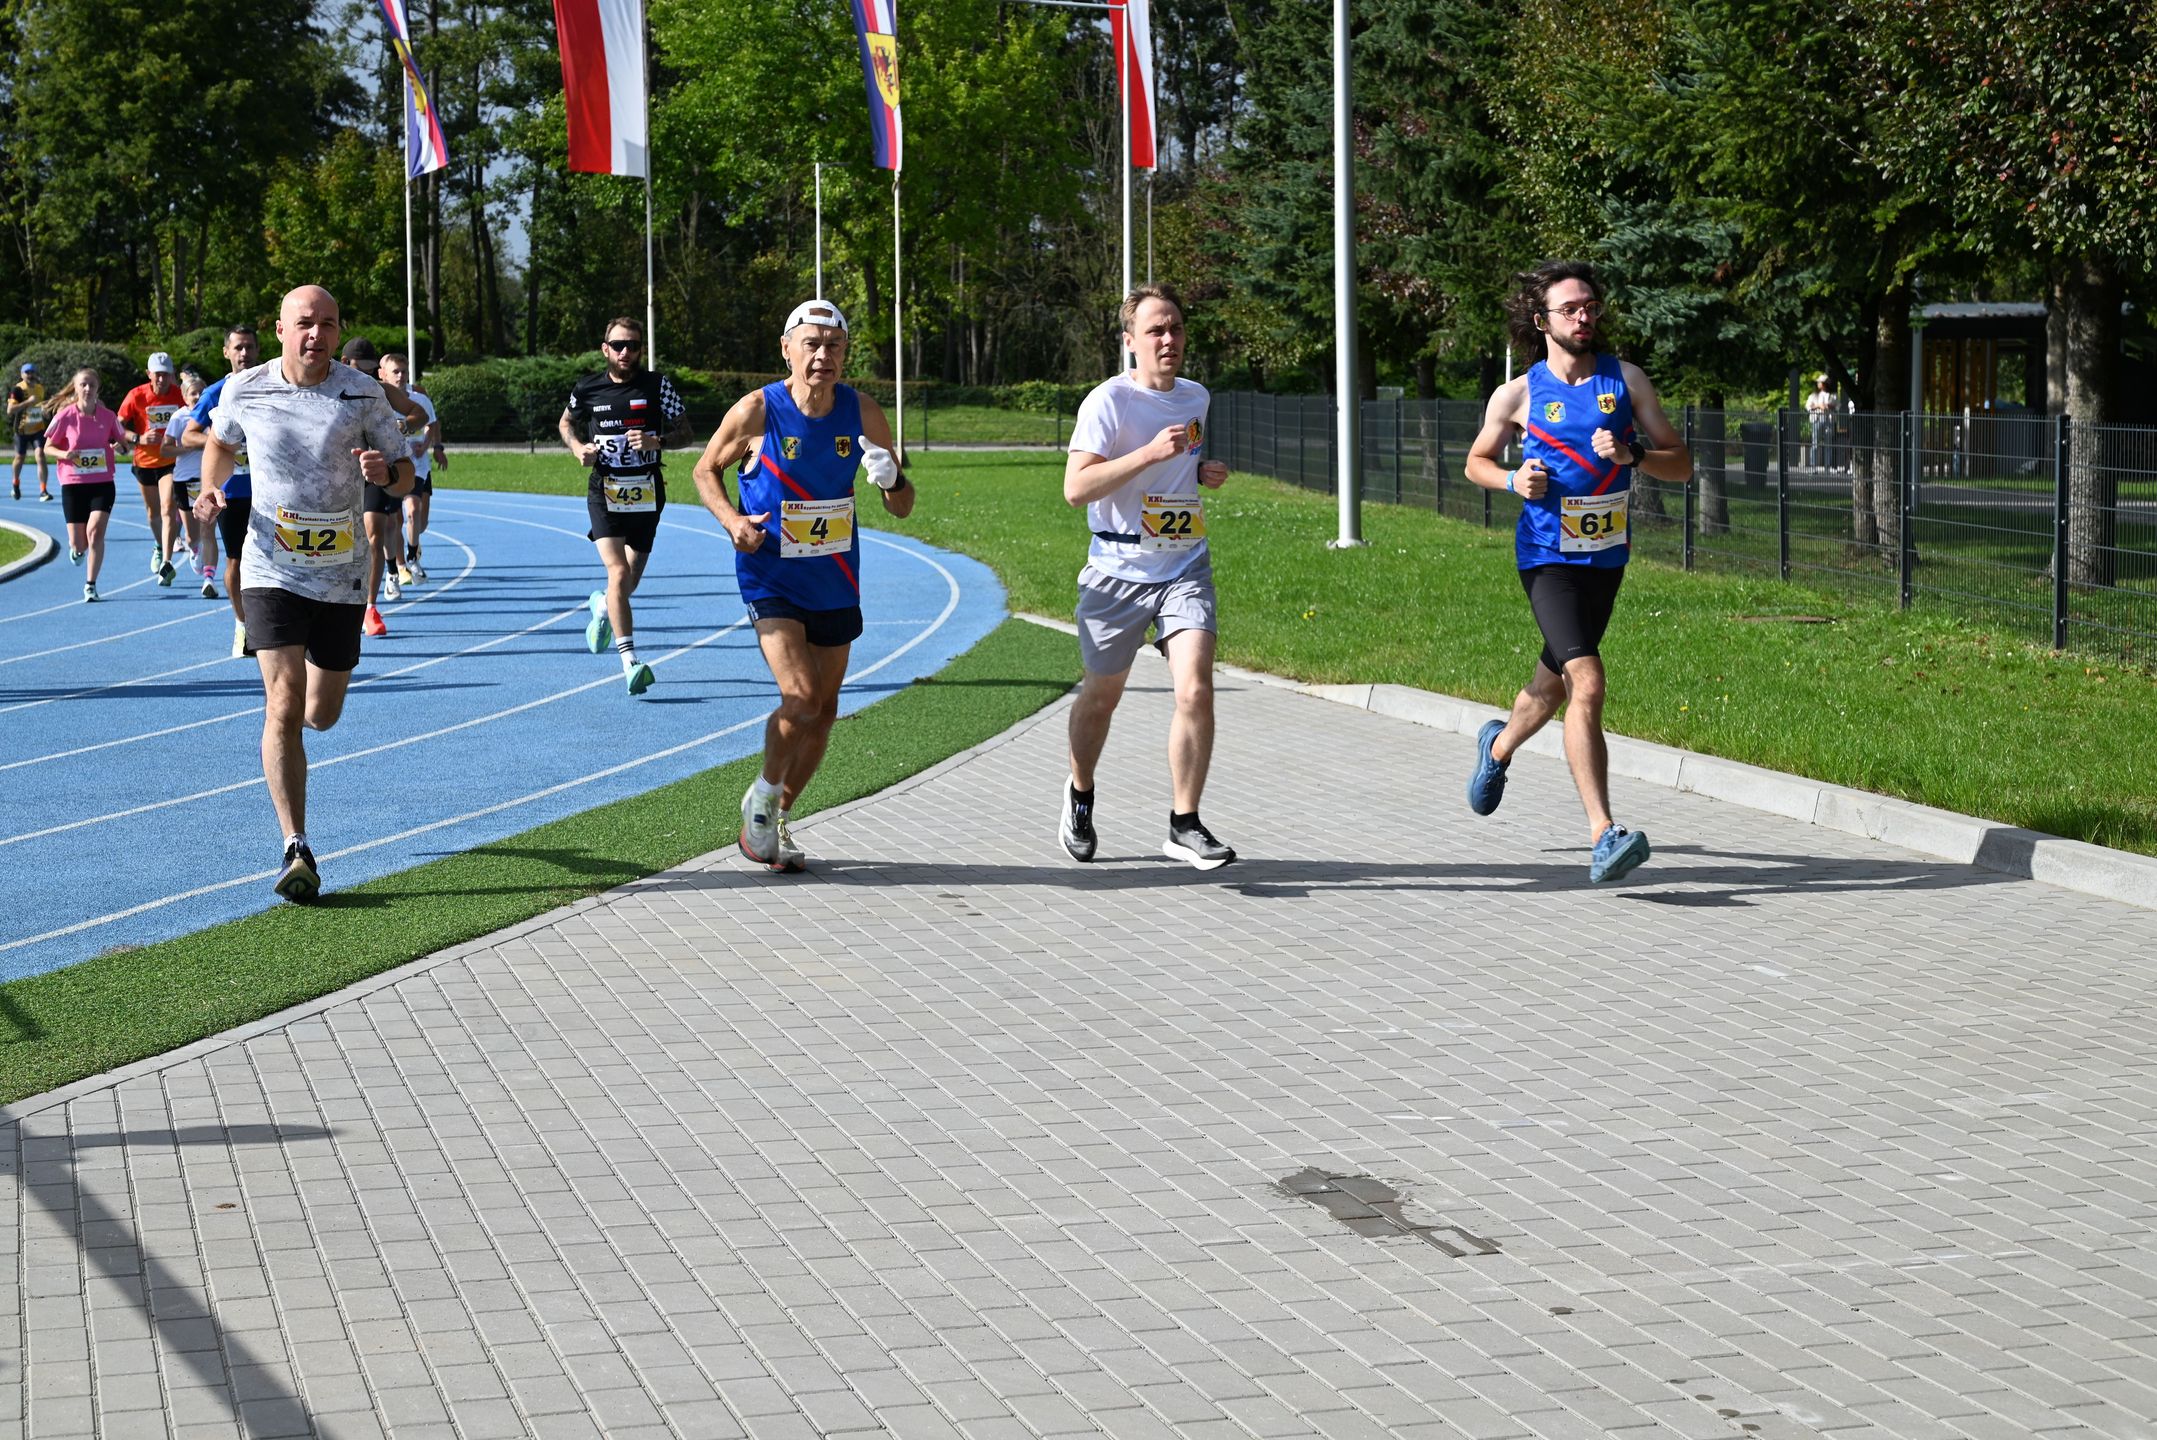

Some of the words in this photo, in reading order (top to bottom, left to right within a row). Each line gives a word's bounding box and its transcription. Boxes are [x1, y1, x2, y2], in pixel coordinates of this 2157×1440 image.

[155, 411, 171, 423] 38
[1548, 403, 1561, 419] LECH
[81, 455, 98, 467] 82
[616, 486, 643, 502] 43
[1148, 495, 1163, 503] XXI
[1567, 498, 1583, 506] XXI
[282, 510, 299, 520] XXI
[1160, 510, 1192, 534] 22
[1580, 510, 1614, 536] 61
[810, 516, 829, 539] 4
[296, 528, 337, 551] 12
